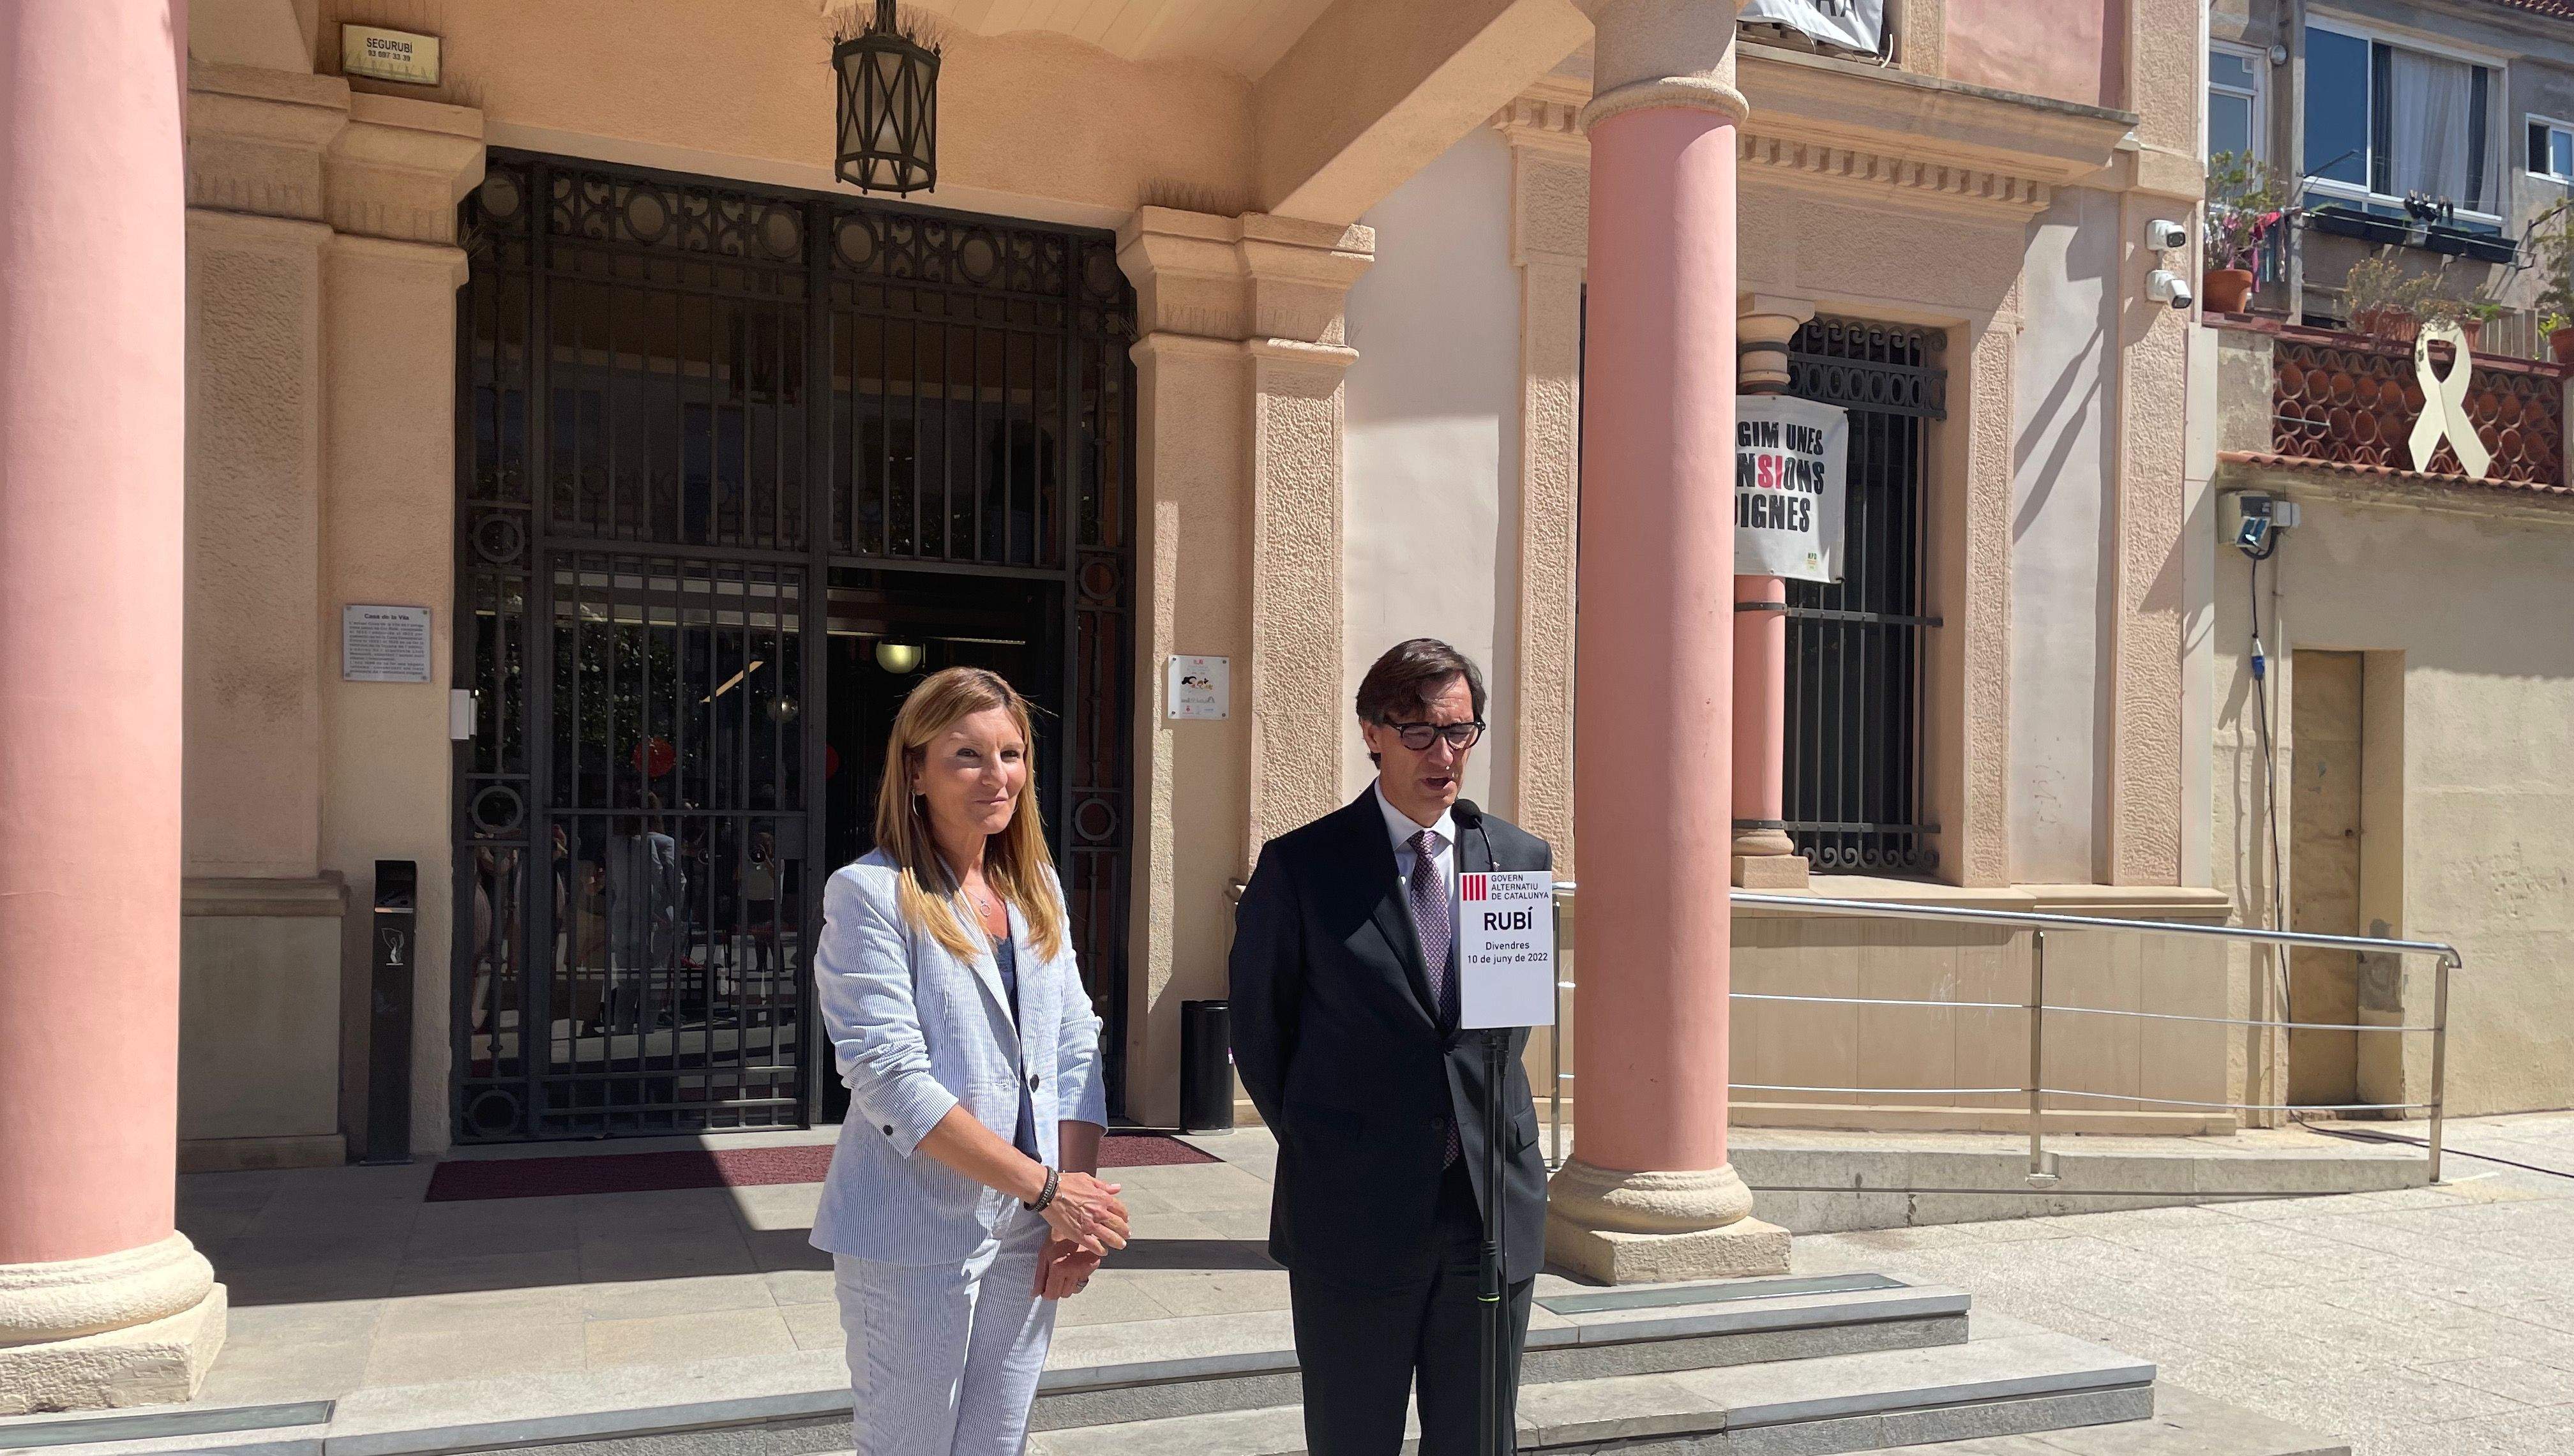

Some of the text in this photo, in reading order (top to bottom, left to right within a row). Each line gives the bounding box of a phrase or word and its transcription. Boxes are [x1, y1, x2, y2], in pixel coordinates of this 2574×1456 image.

[1737, 421, 1823, 456] GIM UNES
[1736, 453, 1825, 495] NSIONS
[1491, 883, 1539, 891] ALTERNATIU
[1504, 892, 1549, 900] CATALUNYA
[1484, 906, 1533, 931] RUBÍ
[1486, 941, 1530, 950] Divendres
[1468, 952, 1548, 965] 10 de juny de 2022
